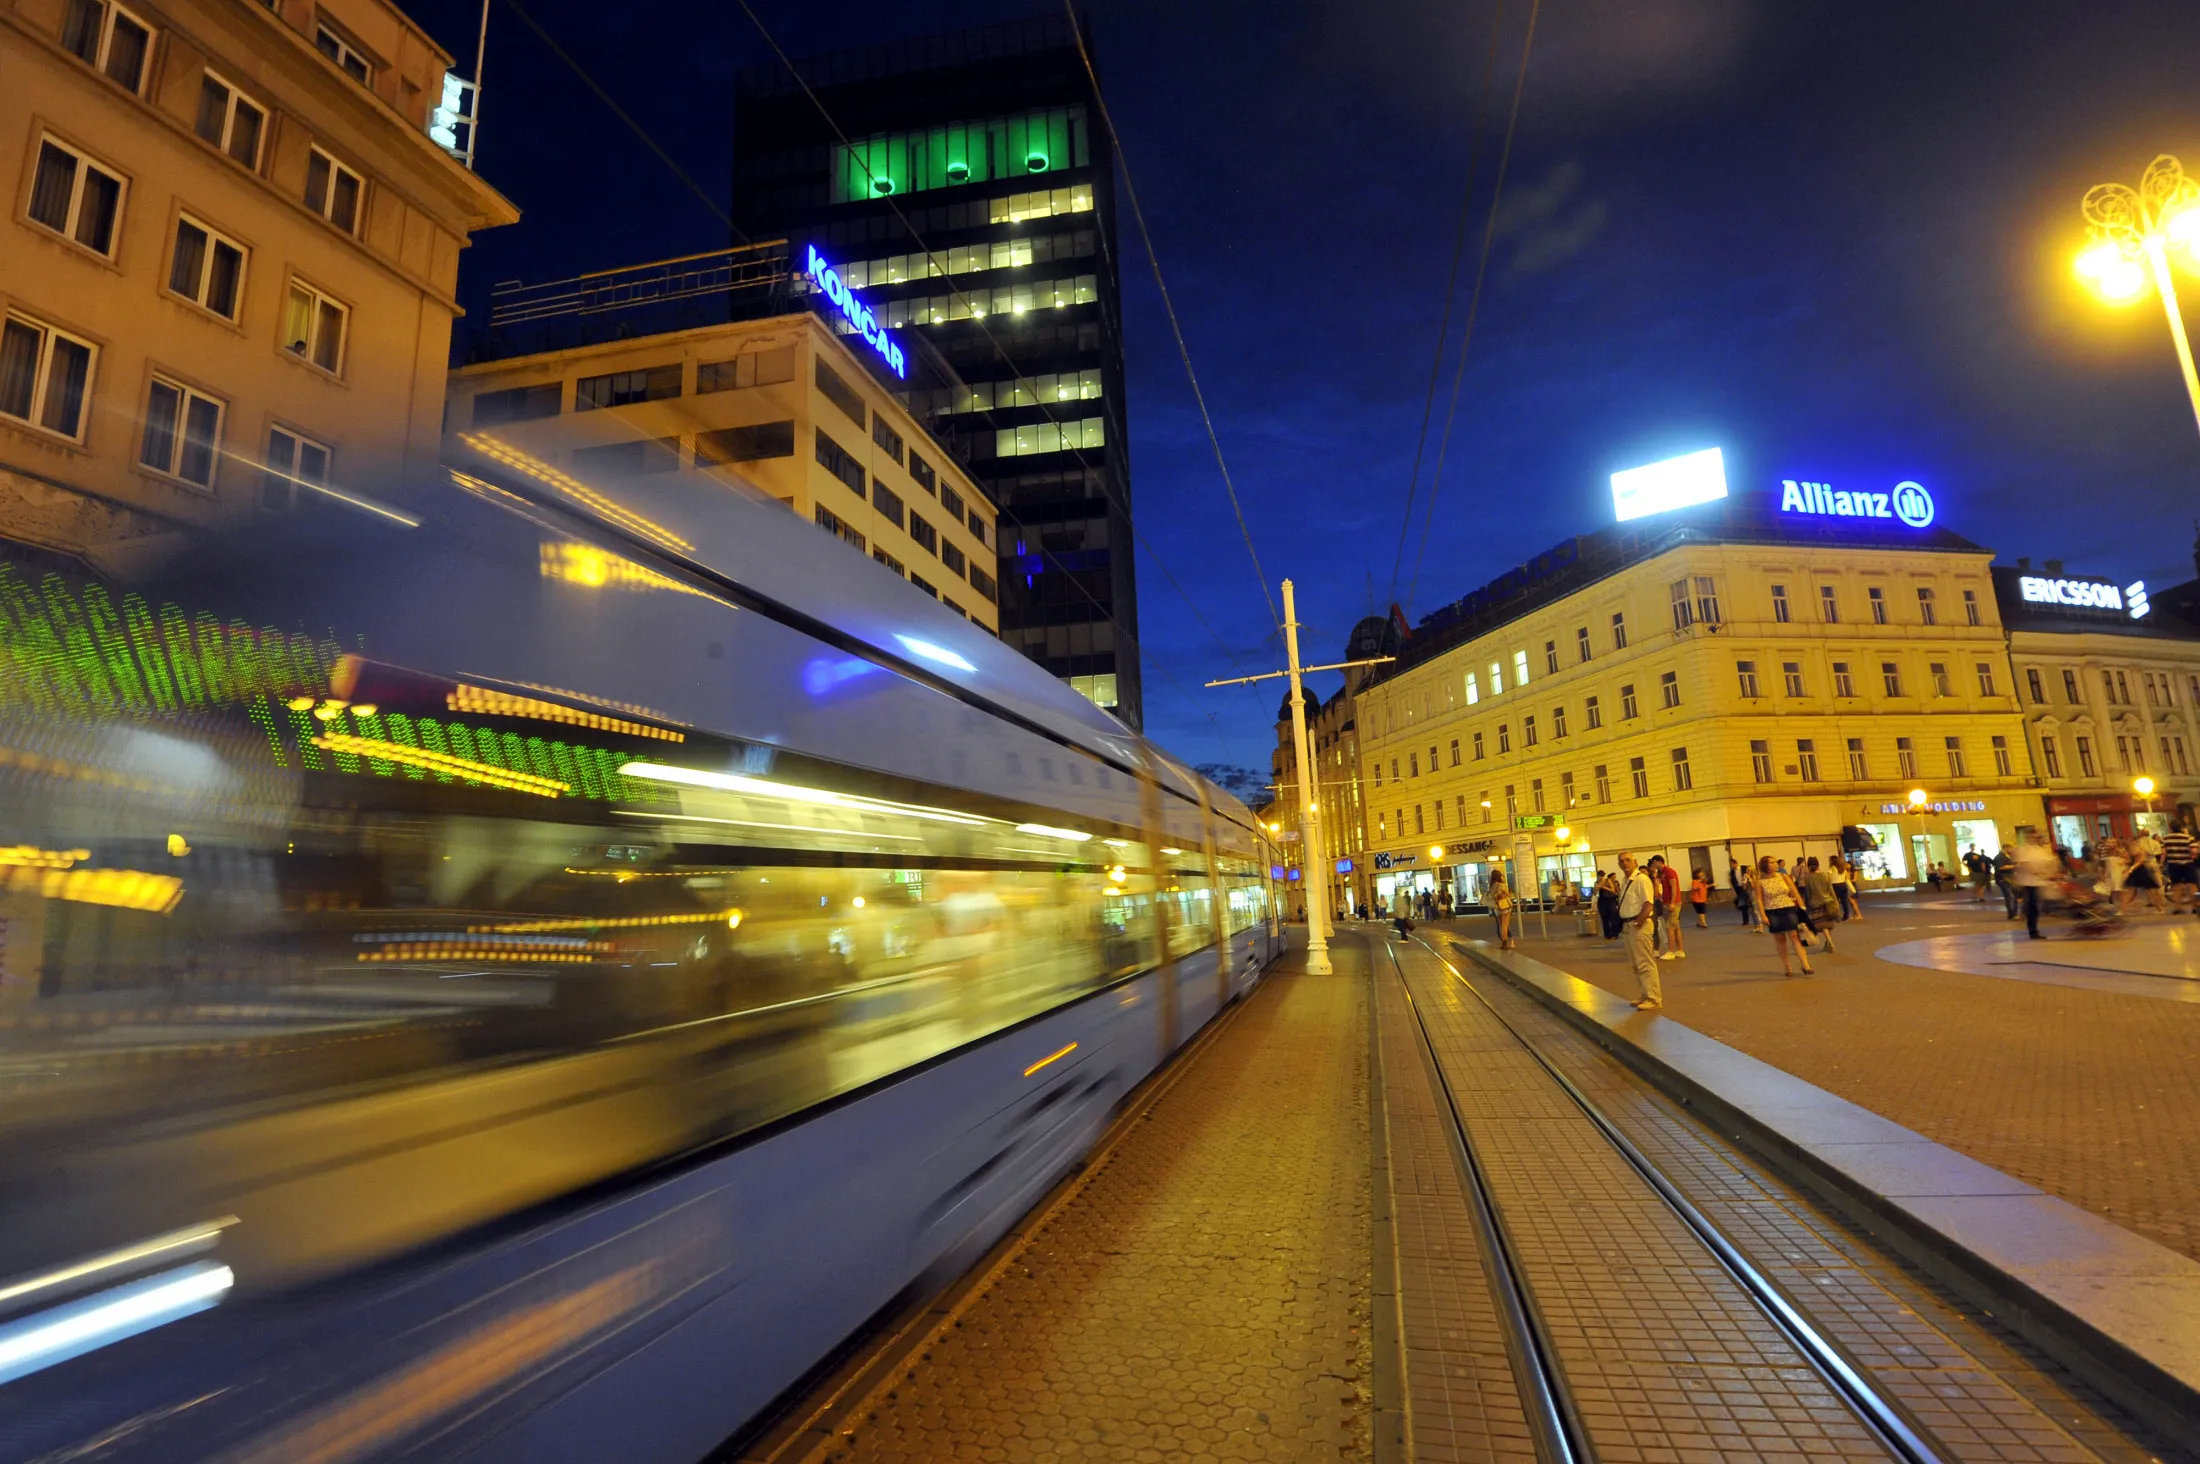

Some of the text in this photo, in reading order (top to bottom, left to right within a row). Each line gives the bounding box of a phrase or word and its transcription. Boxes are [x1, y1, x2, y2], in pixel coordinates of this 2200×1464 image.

[808, 243, 905, 380] KONČAR
[1781, 479, 1893, 518] Allianz
[2019, 576, 2123, 610] ERICSSON
